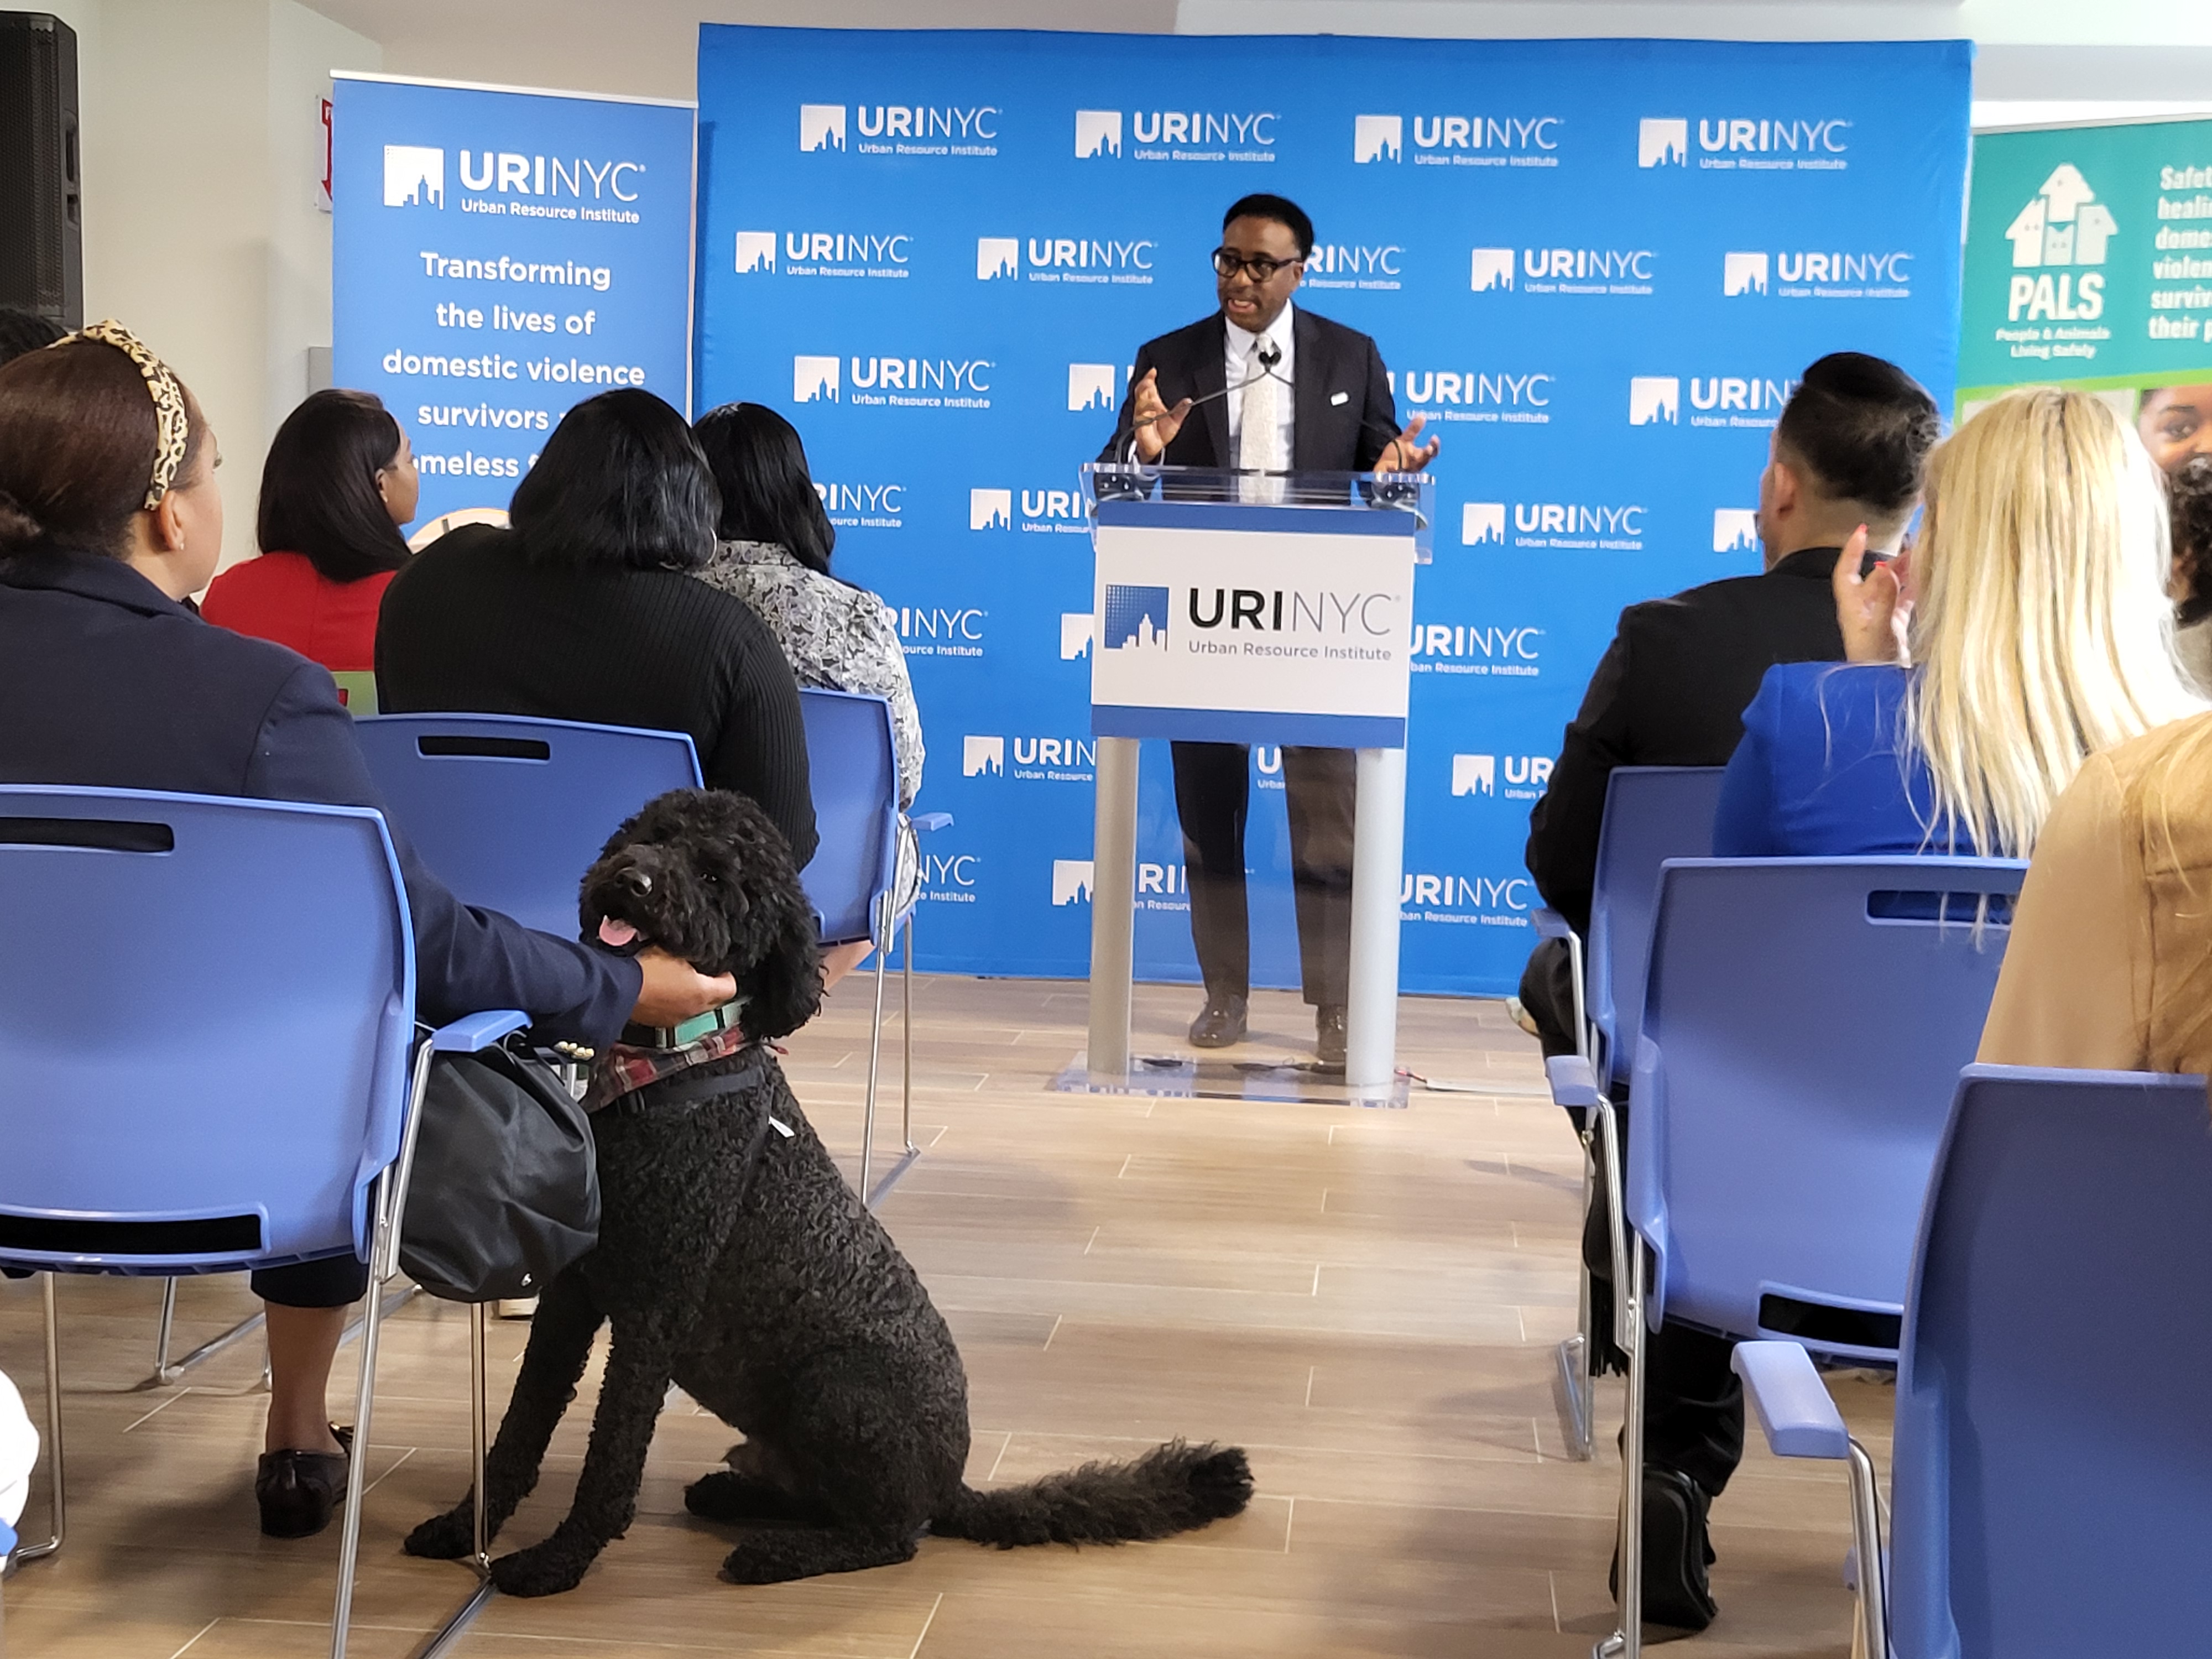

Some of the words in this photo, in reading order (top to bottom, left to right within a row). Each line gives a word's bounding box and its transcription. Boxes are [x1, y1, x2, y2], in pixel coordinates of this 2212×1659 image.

[858, 106, 996, 138] URINYC
[1134, 112, 1274, 144] URINYC
[1415, 117, 1557, 149] URINYC
[1699, 119, 1845, 152] URINYC
[859, 144, 893, 153] Urban
[896, 144, 948, 154] Resource
[951, 145, 997, 155] Institute
[1134, 150, 1169, 160] Urban
[1172, 150, 1225, 160] Resource
[1229, 152, 1275, 161] Institute
[1415, 155, 1449, 164] Urban
[1453, 155, 1506, 165] Resource
[1510, 156, 1558, 166] Institute
[460, 150, 639, 201] URINYC
[2161, 165, 2212, 190] Safet
[462, 199, 505, 214] Urban
[510, 202, 576, 219] Resource
[581, 207, 639, 223] Institute
[2158, 196, 2212, 220] heali
[786, 232, 907, 262] URINYC
[2156, 226, 2212, 249] dome
[1029, 238, 1152, 268] URINYC
[1303, 245, 1401, 275] RINYC
[1525, 249, 1651, 279] URINYC
[1778, 253, 1909, 281] URINYC
[2153, 254, 2212, 279] violen
[420, 252, 610, 290] Transforming
[787, 266, 817, 275] Urban
[820, 267, 865, 276] Resource
[868, 268, 909, 277] Institute
[2008, 272, 2104, 321] PALS
[2152, 285, 2212, 309] surviv
[436, 302, 483, 328] the
[494, 305, 555, 332] lives
[566, 310, 595, 335] of
[2149, 315, 2199, 338] their
[383, 349, 517, 379] domestic
[527, 357, 644, 385] violence
[852, 357, 989, 390] URINYC
[852, 394, 885, 404] Urban
[889, 395, 941, 406] Resource
[945, 398, 990, 408] Institute
[1406, 372, 1548, 405] URINYC
[1691, 377, 1790, 410] URIN
[419, 403, 548, 429] survivors
[1730, 416, 1778, 427] Resourc
[413, 450, 519, 478] meless
[813, 484, 901, 513] INYC
[1021, 490, 1096, 518] URI
[829, 517, 859, 527] ource
[861, 518, 901, 527] Institute
[1515, 504, 1642, 535] URINYC
[886, 607, 983, 640] INYC
[1189, 588, 1392, 636] URINYC
[902, 645, 934, 655] ource
[937, 646, 983, 656] Institute
[1190, 641, 1237, 654] Urban
[1244, 643, 1318, 657] Resource
[1325, 646, 1391, 660] Institute
[1410, 662, 1432, 673] ban
[1436, 662, 1488, 674] Resource
[1492, 665, 1538, 675] Institute
[1014, 737, 1097, 766] URIN
[1014, 770, 1045, 779] Urban
[1048, 771, 1093, 781] Resource
[930, 891, 975, 902] Institute
[1400, 911, 1421, 921] ban
[1425, 911, 1477, 924] Resource
[1481, 915, 1527, 926] Institute
